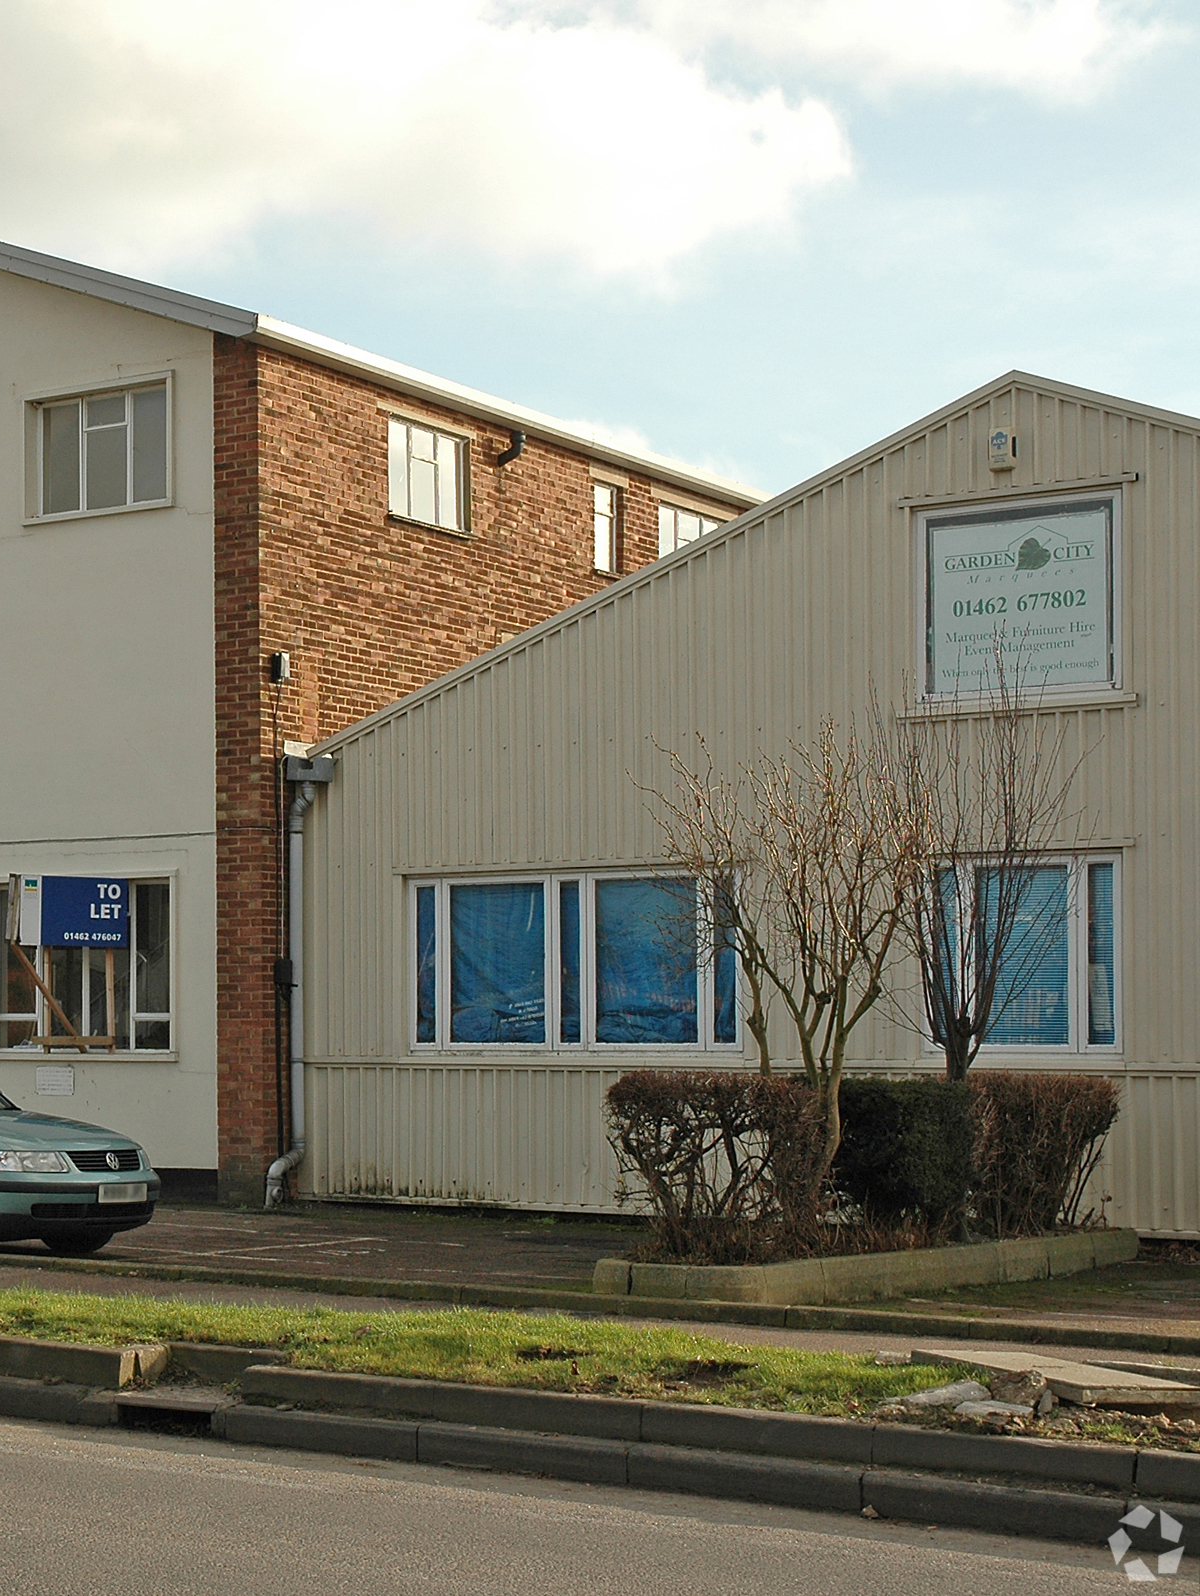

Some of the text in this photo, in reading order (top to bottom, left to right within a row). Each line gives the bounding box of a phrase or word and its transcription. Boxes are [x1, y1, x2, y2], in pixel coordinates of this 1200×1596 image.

[944, 544, 1094, 571] GARDEN CITY
[967, 568, 1075, 585] Marquees
[952, 588, 1087, 618] 01462 677802
[945, 631, 995, 645] Marquee
[1012, 623, 1066, 638] Furniture
[1069, 621, 1096, 633] Hire
[1000, 638, 1075, 654] Management
[1030, 662, 1038, 671] is
[1039, 660, 1063, 673] good
[1064, 657, 1099, 671] enough
[97, 883, 122, 900] TO
[90, 903, 122, 919] LET
[64, 932, 122, 941] 01462 476047
